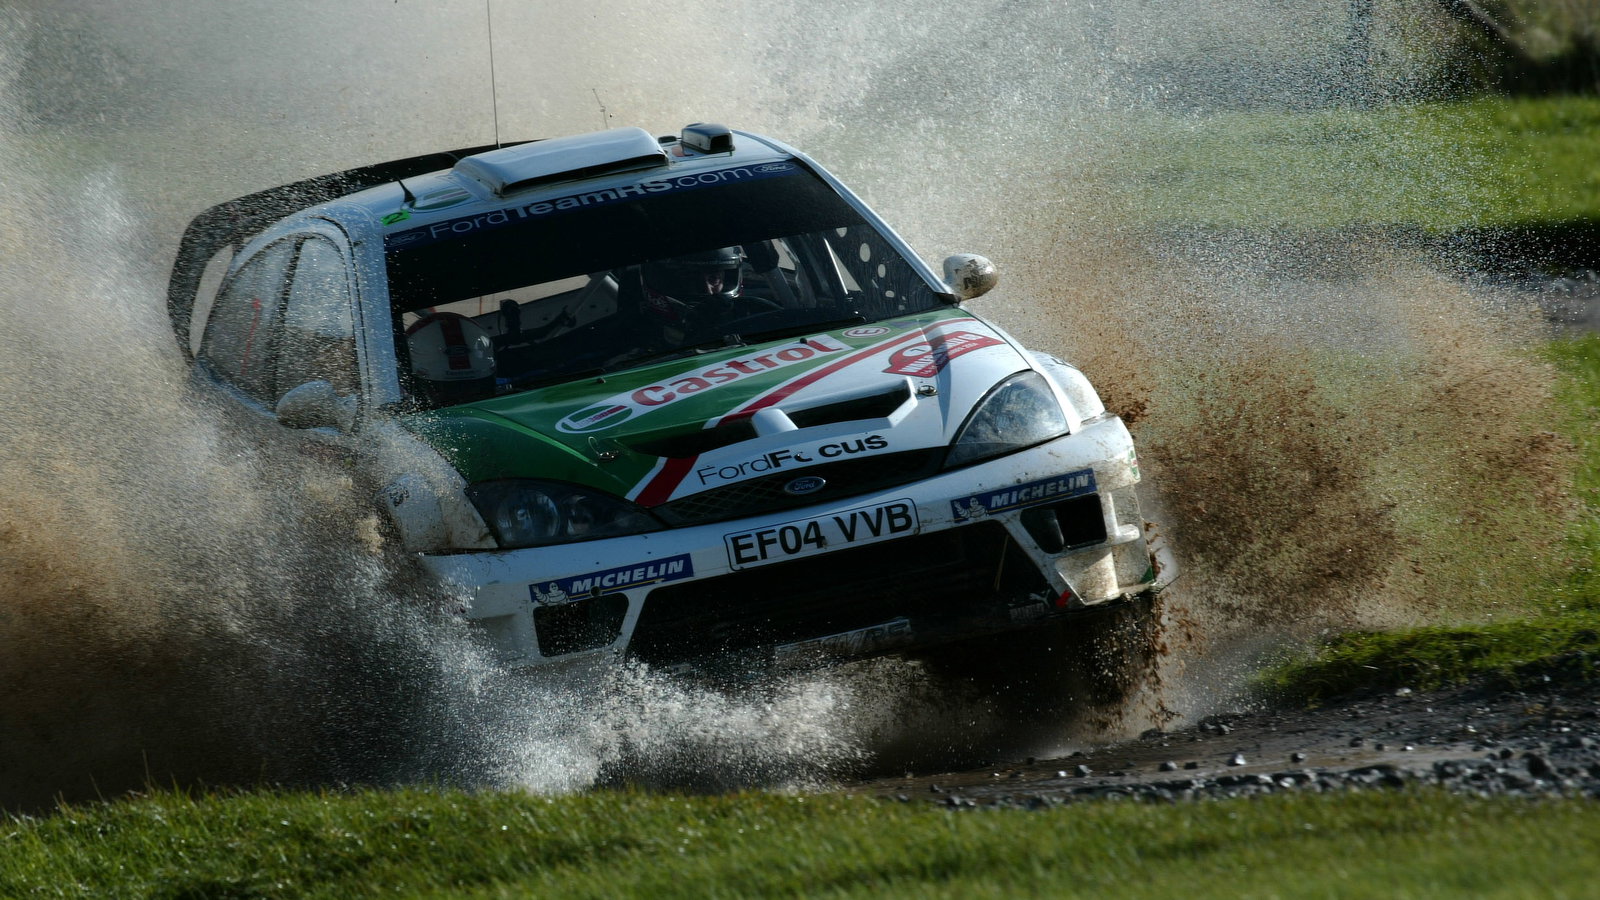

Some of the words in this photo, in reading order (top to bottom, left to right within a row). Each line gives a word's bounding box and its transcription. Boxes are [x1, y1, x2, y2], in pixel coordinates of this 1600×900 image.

[384, 211, 408, 225] 2
[429, 167, 754, 239] FordTeamRS.com
[631, 339, 844, 407] Castrol
[793, 479, 816, 491] Ford
[990, 473, 1089, 508] MICHELIN
[730, 520, 827, 565] EF04
[832, 503, 913, 543] VVB
[571, 559, 684, 594] MICHELIN
